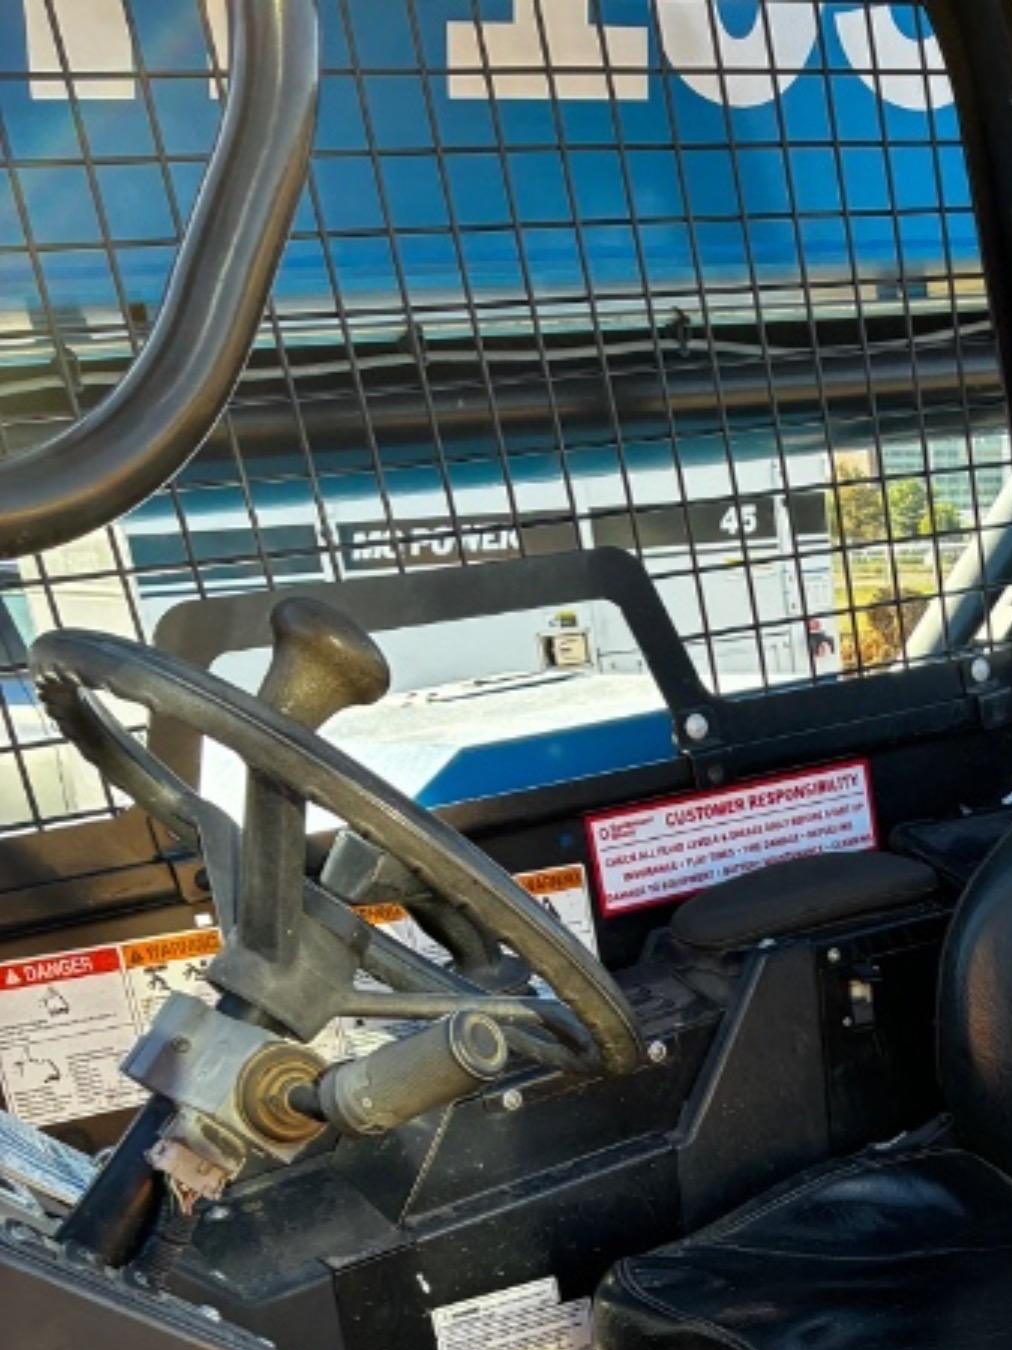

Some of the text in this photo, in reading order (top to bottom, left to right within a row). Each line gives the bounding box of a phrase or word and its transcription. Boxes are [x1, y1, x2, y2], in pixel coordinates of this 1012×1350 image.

[719, 503, 758, 536] 45
[409, 524, 521, 557] POWER
[664, 772, 859, 827] CUSTOMER RESPONSIBILITY
[23, 956, 93, 982] DANGER
